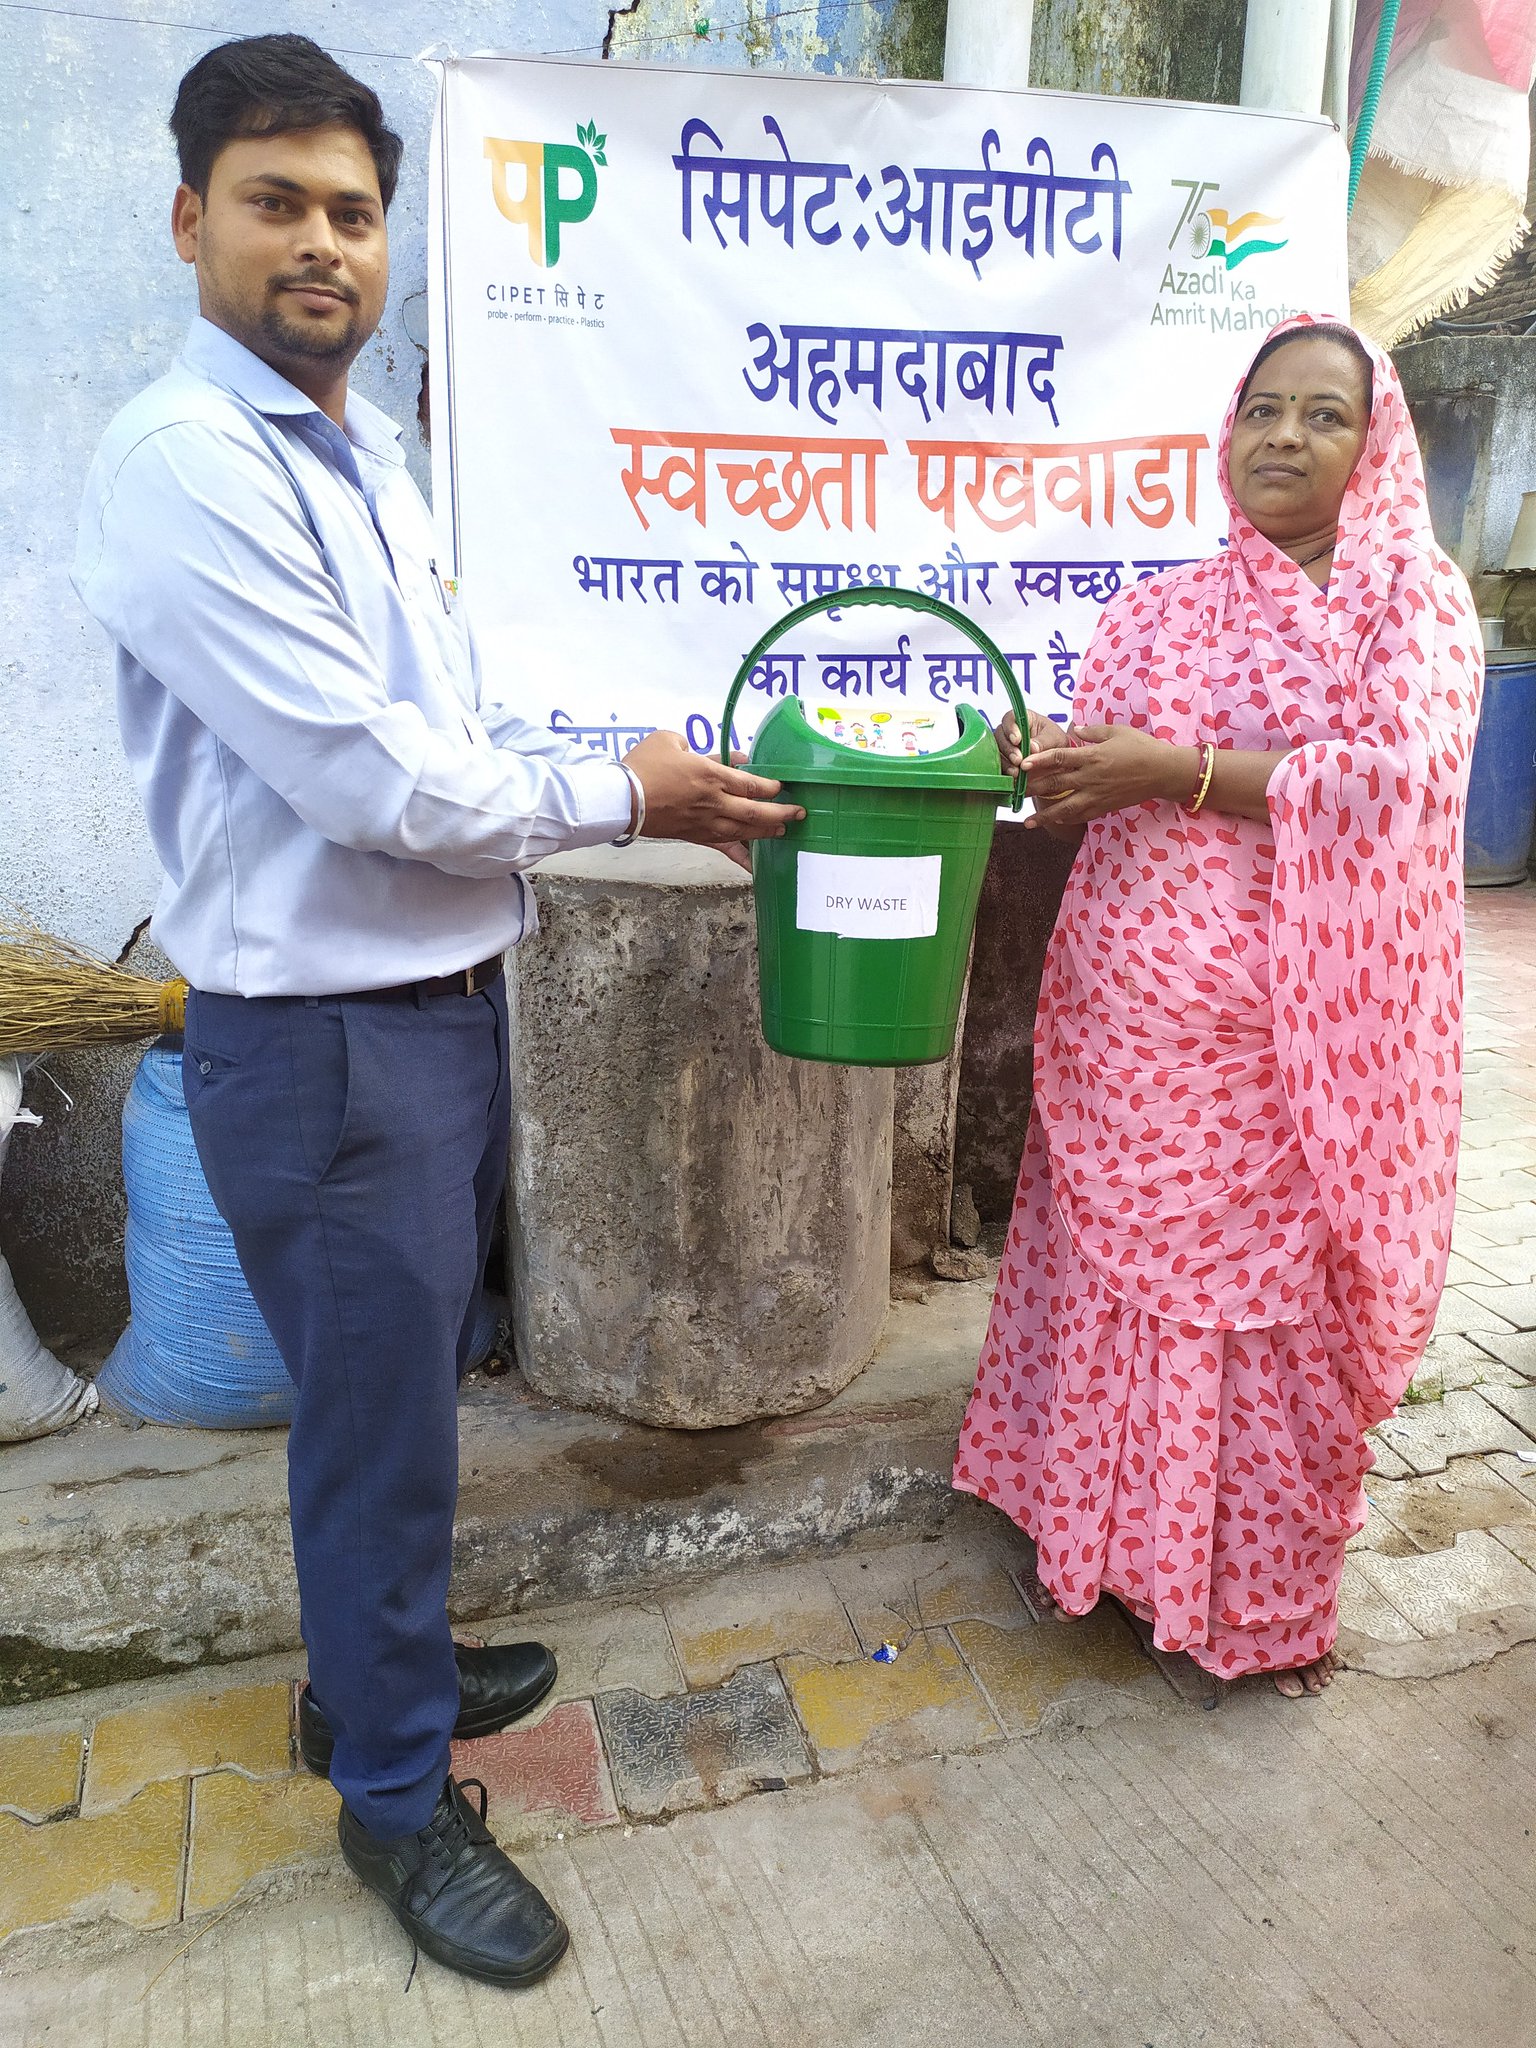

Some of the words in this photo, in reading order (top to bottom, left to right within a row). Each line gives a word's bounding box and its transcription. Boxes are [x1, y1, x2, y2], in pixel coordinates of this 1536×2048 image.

[486, 284, 545, 305] CIPET
[1159, 263, 1224, 295] Azadi
[1230, 280, 1256, 301] Ka
[487, 309, 508, 320] probe
[514, 311, 542, 323] perform
[548, 315, 575, 325] practice
[580, 317, 605, 328] Plastics
[1150, 302, 1206, 326] Amrit
[742, 322, 1064, 428] अहमदाबाद
[609, 427, 888, 533] स्वच्छता
[906, 433, 1211, 534] पखवाडा
[572, 554, 684, 604] भारत
[694, 541, 760, 606] को
[916, 541, 999, 606] और
[1009, 560, 1125, 607] स्वच्छ
[742, 653, 806, 698] का
[816, 634, 912, 698] कार्य
[1046, 630, 1081, 701] है
[825, 895, 853, 909] DRY
[857, 897, 907, 911] WASTE
